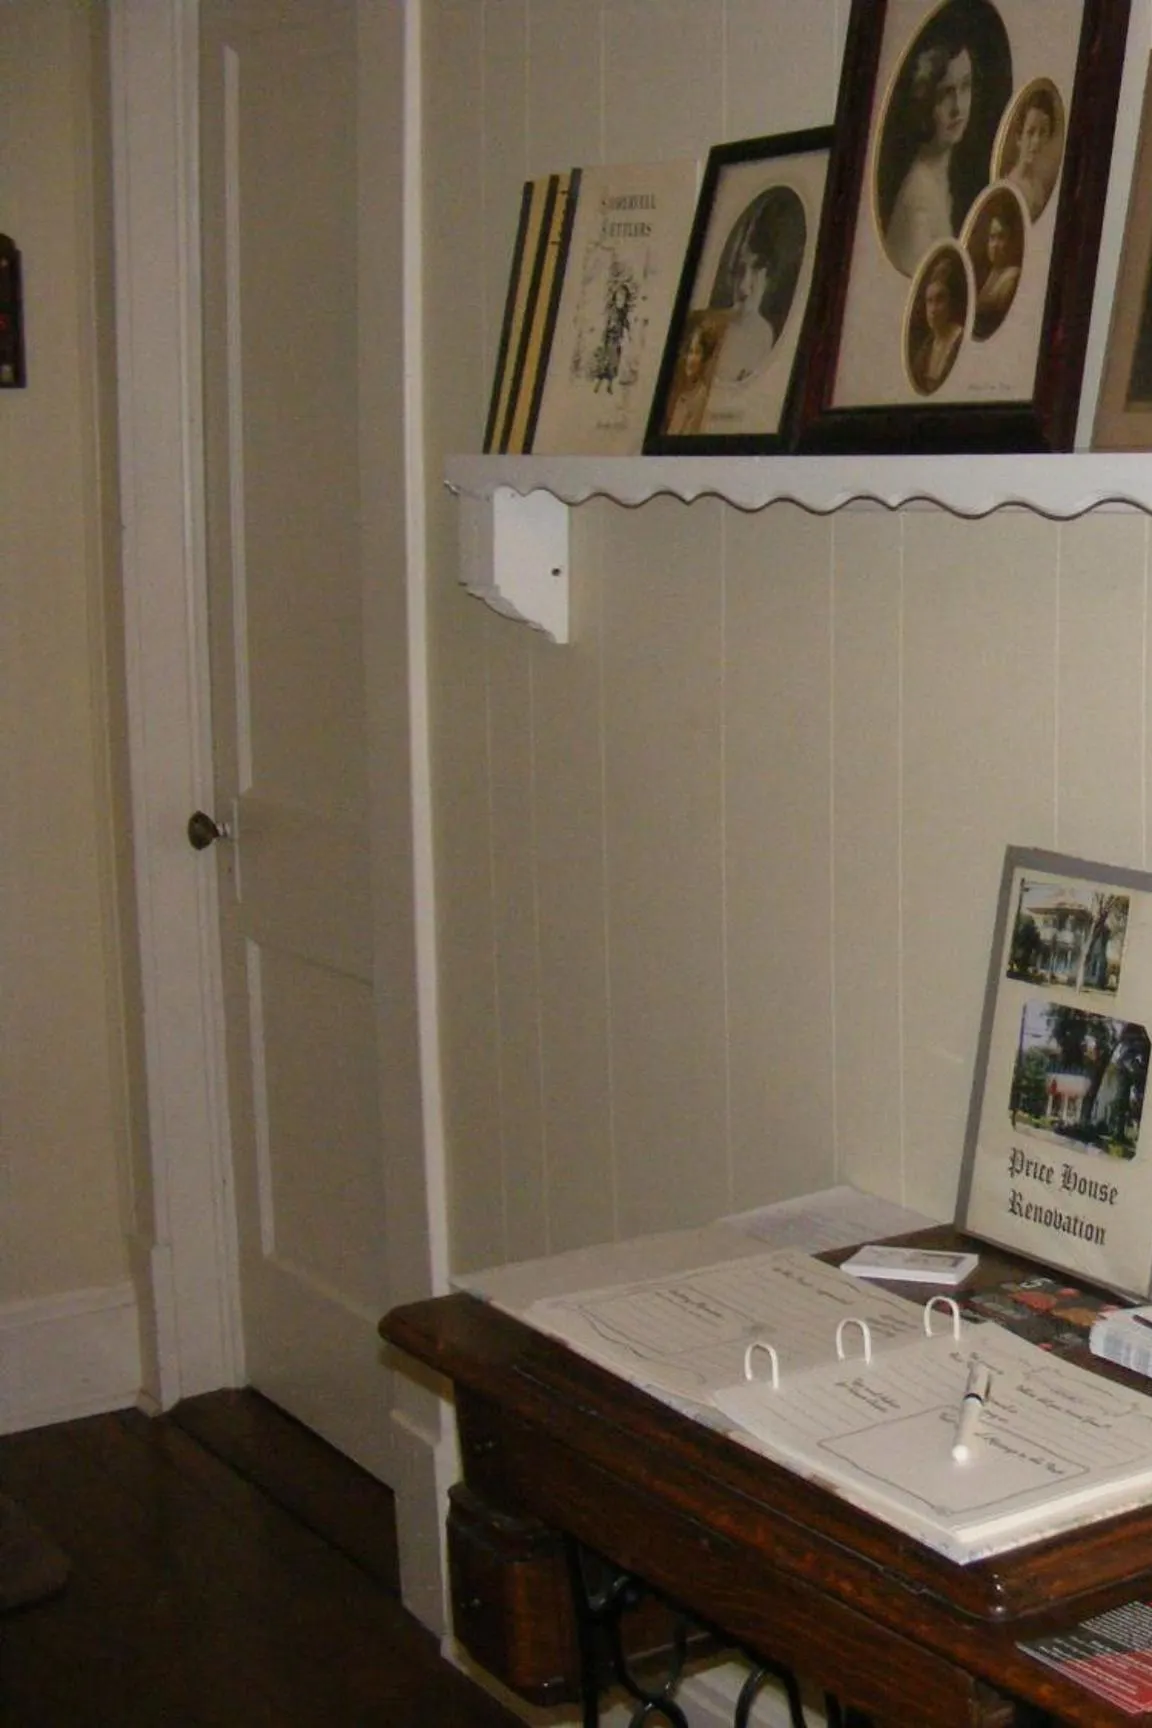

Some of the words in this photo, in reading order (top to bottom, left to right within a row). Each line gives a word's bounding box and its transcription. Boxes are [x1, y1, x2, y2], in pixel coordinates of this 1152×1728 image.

[1008, 1147, 1055, 1184] Price
[1061, 1163, 1119, 1205] House
[1008, 1188, 1107, 1246] Renovation
